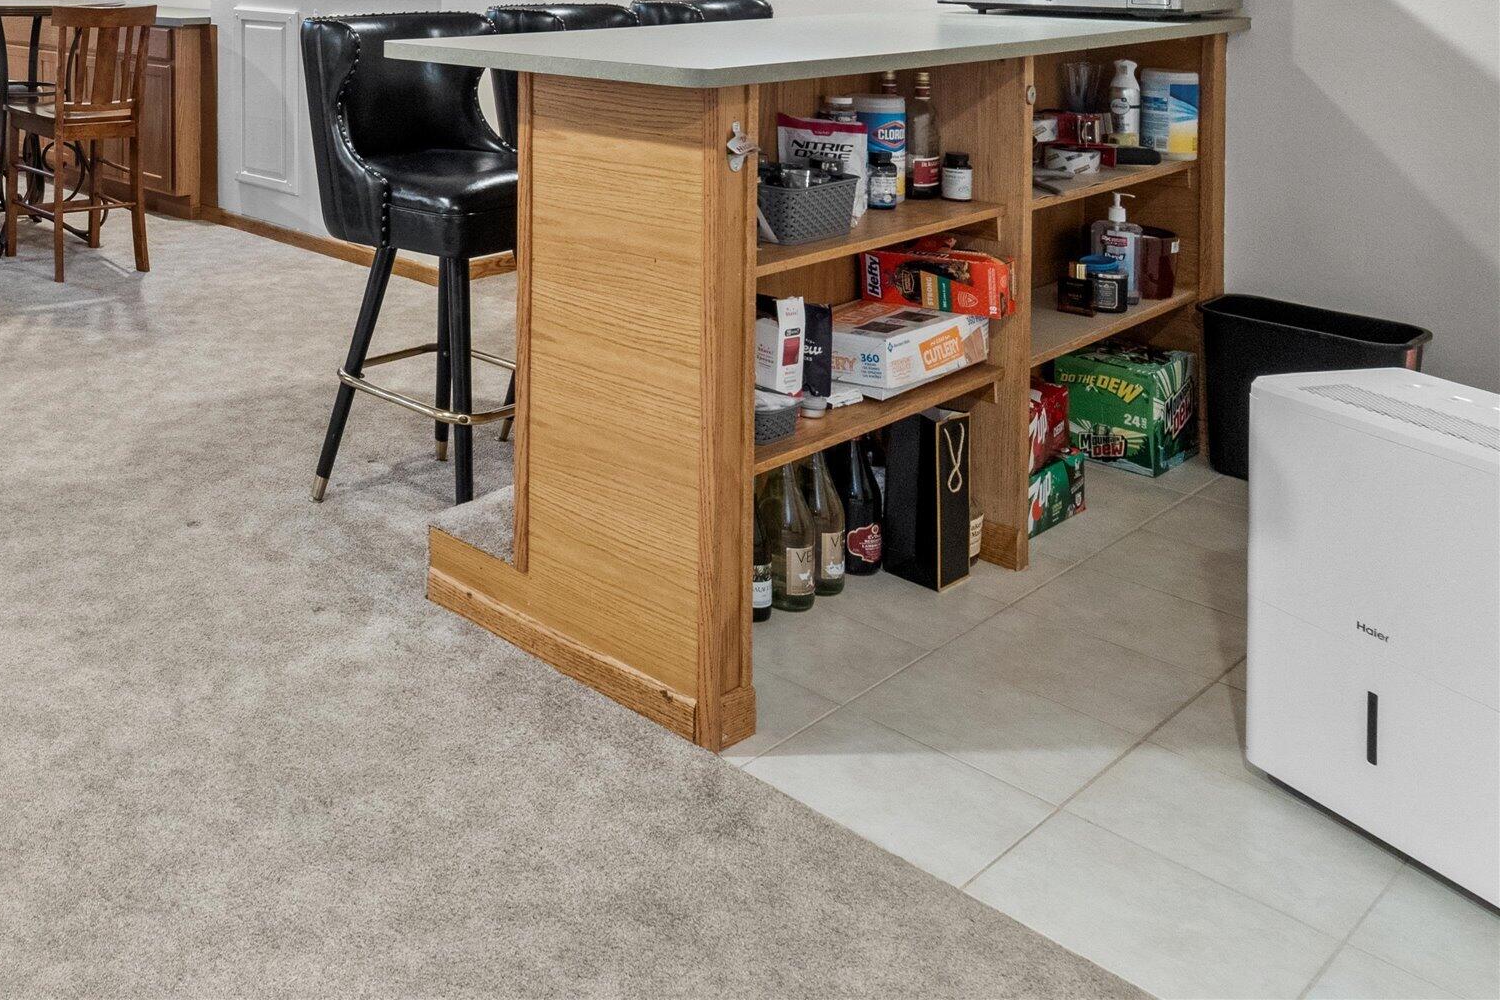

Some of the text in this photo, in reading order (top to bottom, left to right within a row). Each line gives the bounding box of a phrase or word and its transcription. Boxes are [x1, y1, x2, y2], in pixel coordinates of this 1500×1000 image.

[878, 128, 905, 140] CLORO
[792, 139, 854, 153] NITRIC
[794, 148, 851, 162] OXIDE
[867, 256, 880, 296] Hefty
[925, 276, 935, 306] STRONG
[860, 353, 880, 364] 360
[923, 337, 959, 365] CUTLERY
[1061, 373, 1144, 404] DO THE DEW
[1123, 413, 1141, 428] 24
[1356, 620, 1390, 643] Haier
